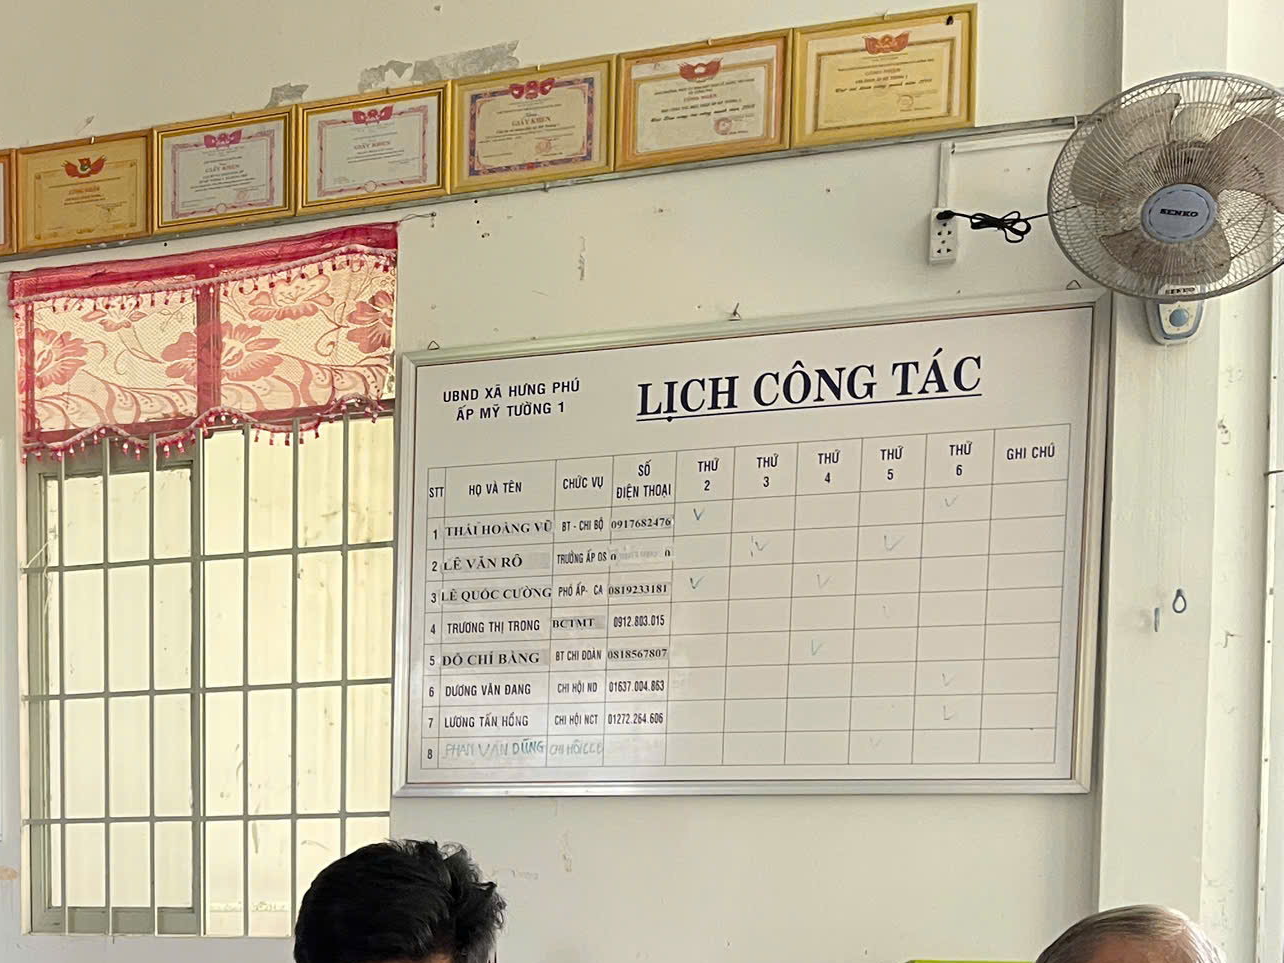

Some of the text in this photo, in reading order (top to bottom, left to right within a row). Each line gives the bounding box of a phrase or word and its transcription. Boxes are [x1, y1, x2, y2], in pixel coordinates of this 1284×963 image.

[1160, 208, 1199, 217] SENKO
[443, 377, 580, 403] UBND XÃ HƯNG PHÚ
[637, 348, 982, 422] LỊCH CÔNG TÁC
[456, 401, 564, 421] ẤP MỸ TƯỜNG 1
[1006, 442, 1055, 460] GHI CHÚ
[638, 459, 652, 477] SỐ
[887, 468, 894, 480] 5
[956, 464, 963, 476] 6
[563, 476, 604, 490] CHỨC VỤ
[763, 476, 770, 487] 3
[824, 472, 830, 483] 4
[469, 481, 522, 497] HỌ VÀ TÊN
[704, 480, 710, 491] 2
[429, 487, 444, 498] STT
[616, 483, 671, 501] ĐIỆN THOẠI
[482, 521, 530, 535] HOÀNG
[534, 519, 552, 532] VŨ
[562, 521, 571, 532] BT
[579, 520, 591, 530] CHI
[594, 516, 604, 531] BỘ
[611, 518, 671, 529] 0917682476
[433, 529, 437, 540] 1
[444, 553, 523, 570] LÊ VĂN RÔ
[586, 549, 596, 562] ẤP
[432, 561, 437, 571] 2
[441, 588, 457, 601] LÊ
[593, 584, 603, 595] CA
[608, 584, 667, 595] 0819233181
[431, 593, 436, 603] 3
[447, 619, 540, 634] TRƯƠNG THỊ TRONG
[613, 614, 665, 628] 0912.803.015
[430, 624, 435, 634] 4
[556, 651, 564, 661] BT
[567, 650, 579, 660] CHI
[608, 649, 667, 659] 0818567807
[429, 655, 435, 666] 5
[429, 687, 434, 697] 6
[445, 682, 531, 697] DƯƠNG VĂN ĐANG
[557, 680, 597, 694] CHI HỘI ND
[428, 718, 433, 728] 7
[444, 715, 475, 728] LƯƠNG
[555, 712, 598, 726] CHI HỘI NCT
[427, 749, 433, 759] 8
